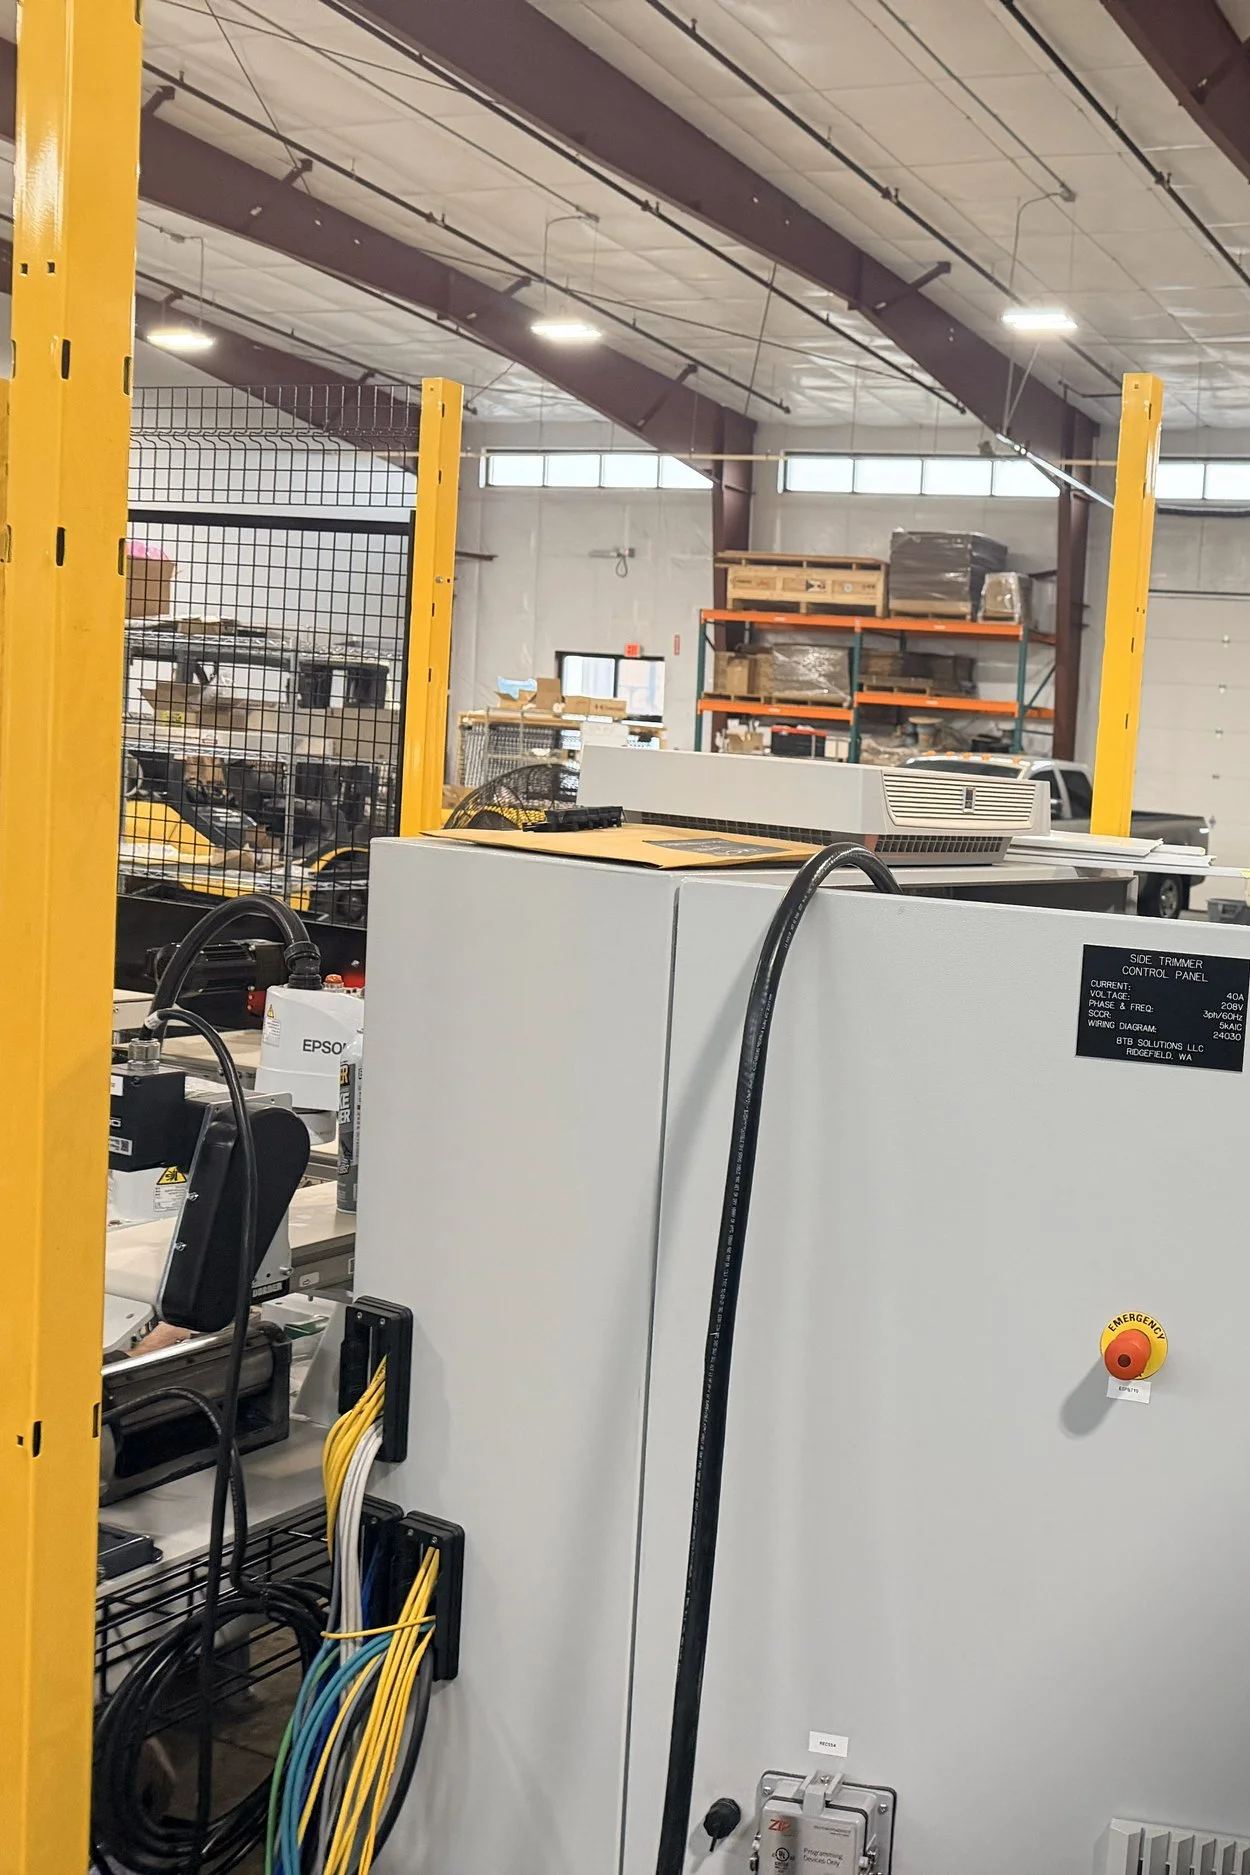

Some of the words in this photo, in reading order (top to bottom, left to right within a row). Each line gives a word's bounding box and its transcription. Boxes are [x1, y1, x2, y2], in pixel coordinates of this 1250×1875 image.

[1130, 953, 1152, 965] SIDE
[1159, 956, 1203, 969] TRIMMER
[1122, 966, 1169, 979] CONTROL
[1175, 971, 1208, 983] PANEL
[1090, 979, 1131, 991] CURRENT:
[1226, 992, 1245, 1001] 40A
[1090, 989, 1131, 1001] VOLTAGE:
[1220, 1002, 1244, 1011] 208V
[1088, 1000, 1115, 1010] PHASE
[1119, 1002, 1126, 1010] &
[1130, 1003, 1154, 1013] FREQ:
[1203, 1010, 1243, 1022] 3ph/60Hz
[1088, 1009, 1112, 1019] SCCR:
[1087, 1019, 1115, 1029] WIRING
[1119, 1022, 1157, 1033] DIAGRAM:
[1212, 1031, 1242, 1041] 24030
[1116, 1037, 1133, 1046] BTB
[1137, 1038, 1183, 1051] SOLUTIONS
[1187, 1043, 1204, 1053] LLC
[1179, 1053, 1193, 1061] WA
[1107, 1313, 1165, 1340] EMERGENCY
